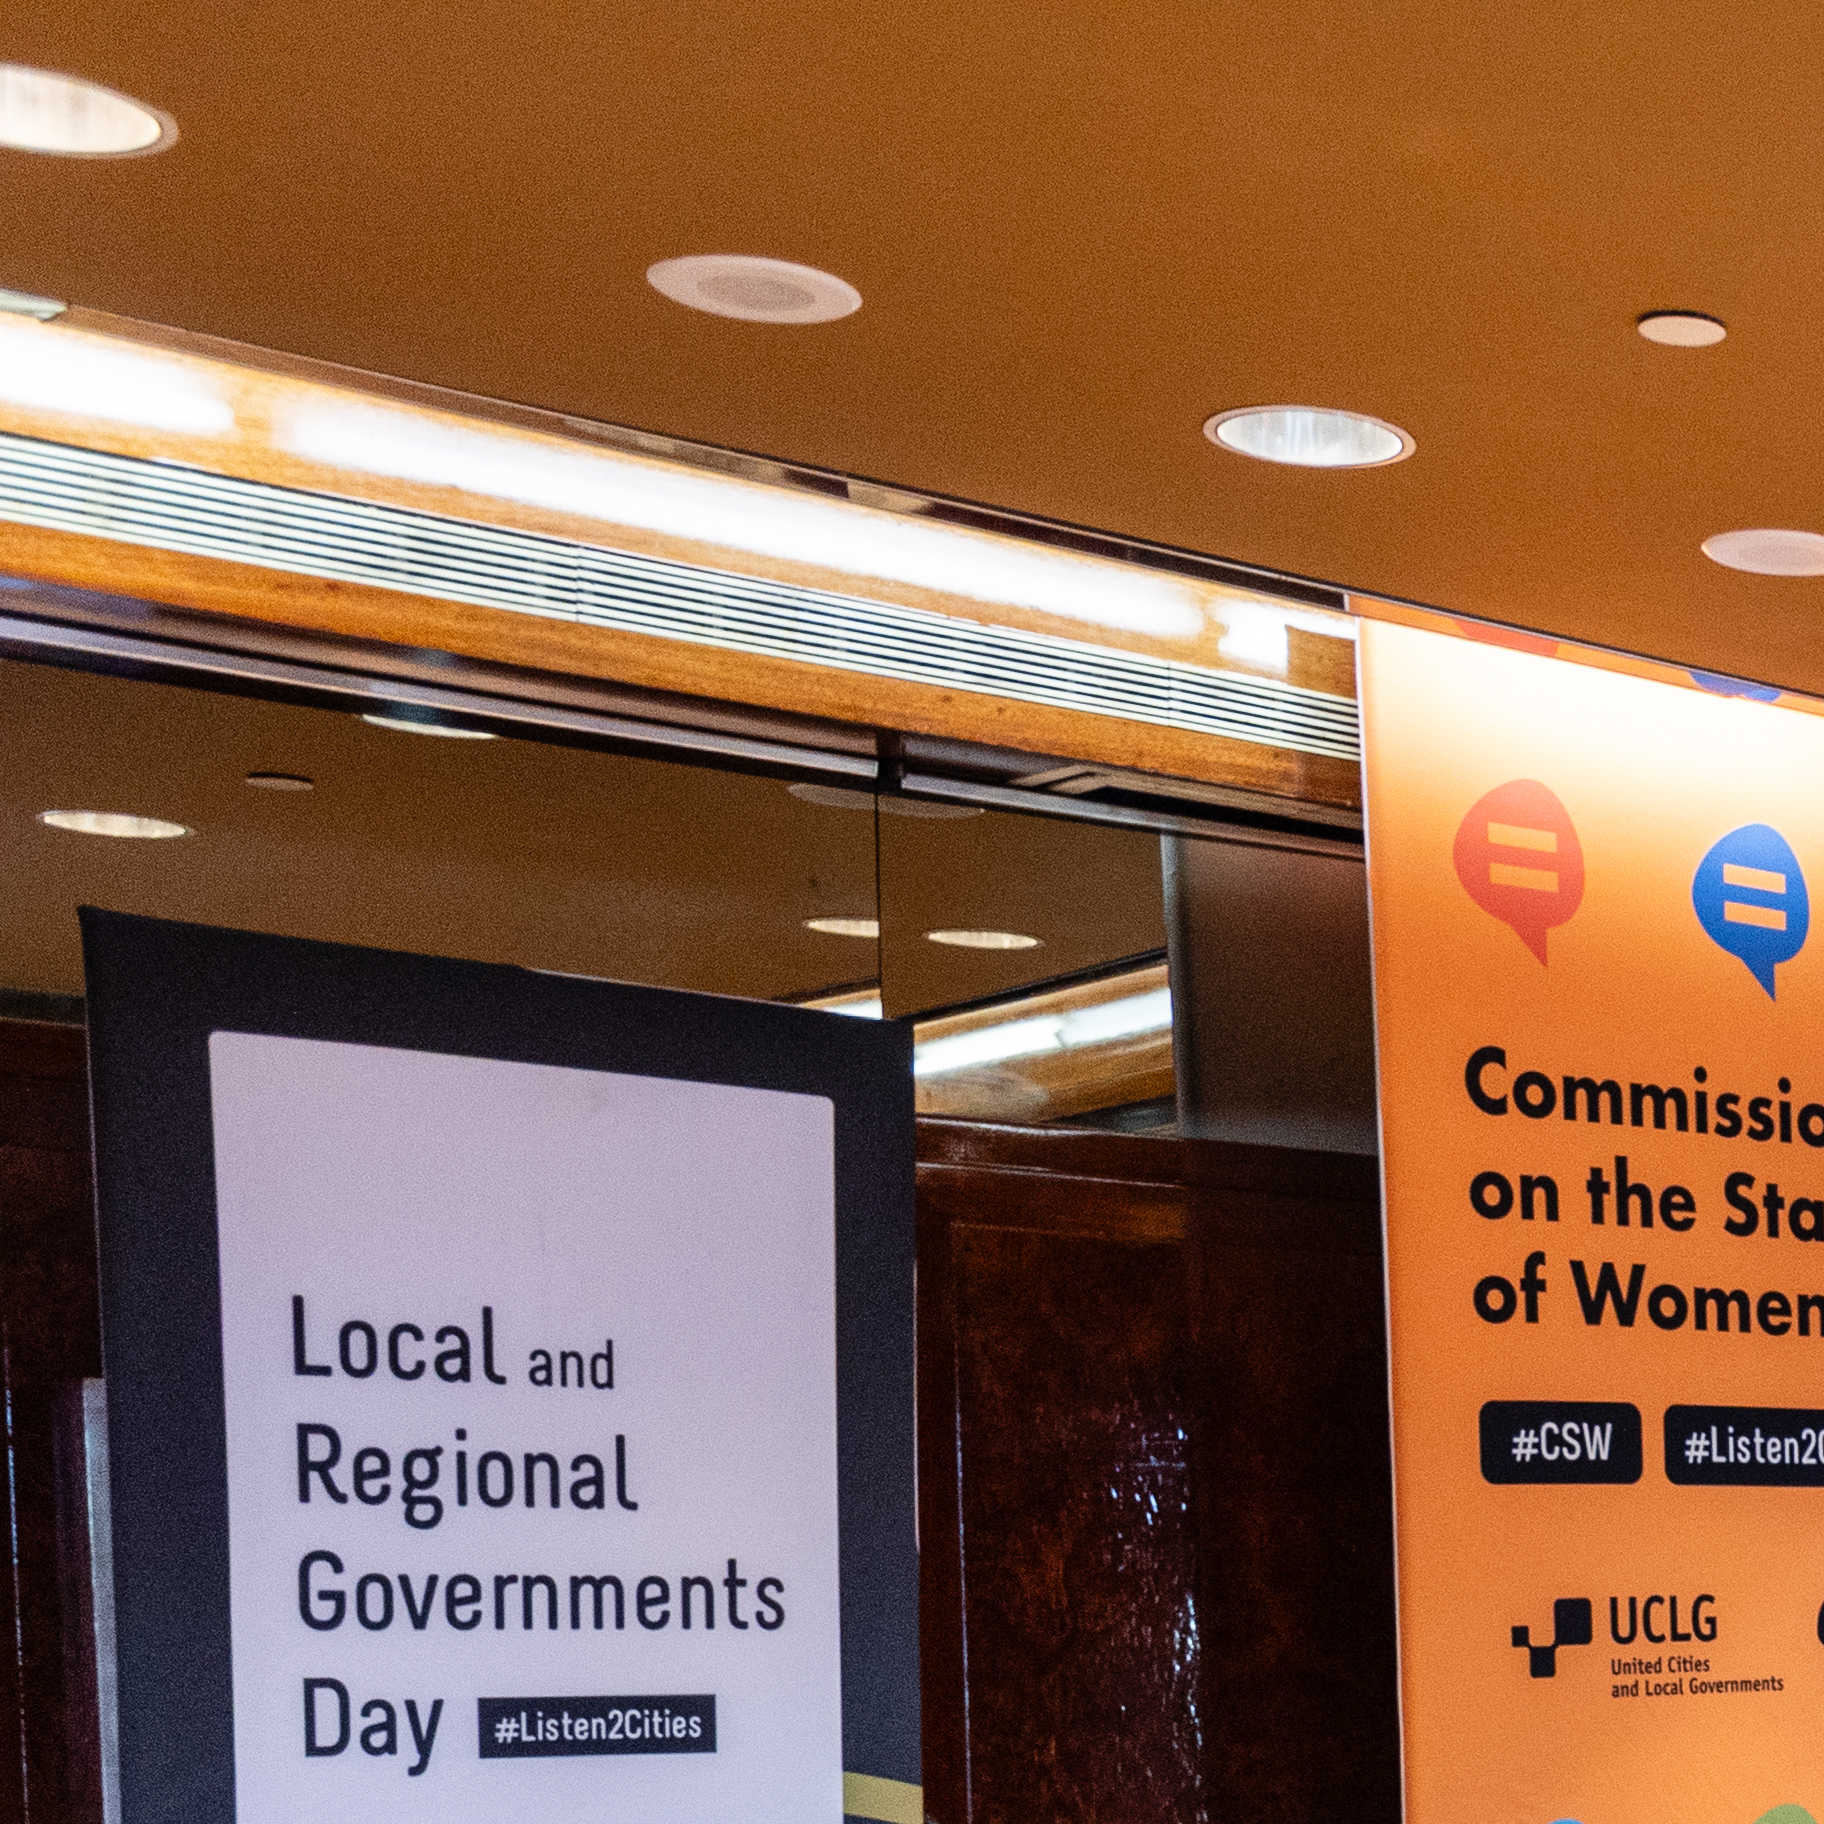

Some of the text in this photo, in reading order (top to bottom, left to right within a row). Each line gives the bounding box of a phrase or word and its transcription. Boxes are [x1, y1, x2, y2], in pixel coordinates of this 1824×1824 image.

[1469, 1170, 1560, 1222] on
[1586, 1156, 1696, 1233] the
[1473, 1250, 1547, 1325] of
[291, 1294, 615, 1390] Local and
[296, 1422, 638, 1529] Regional
[1511, 1422, 1612, 1462] #CSW
[297, 1550, 786, 1631] Governments
[1610, 1594, 1718, 1645] UCLG
[1611, 1654, 1710, 1676] United Cities
[1611, 1675, 1784, 1698] and Local Governments
[302, 1677, 703, 1777] Day #Listen2Cities
